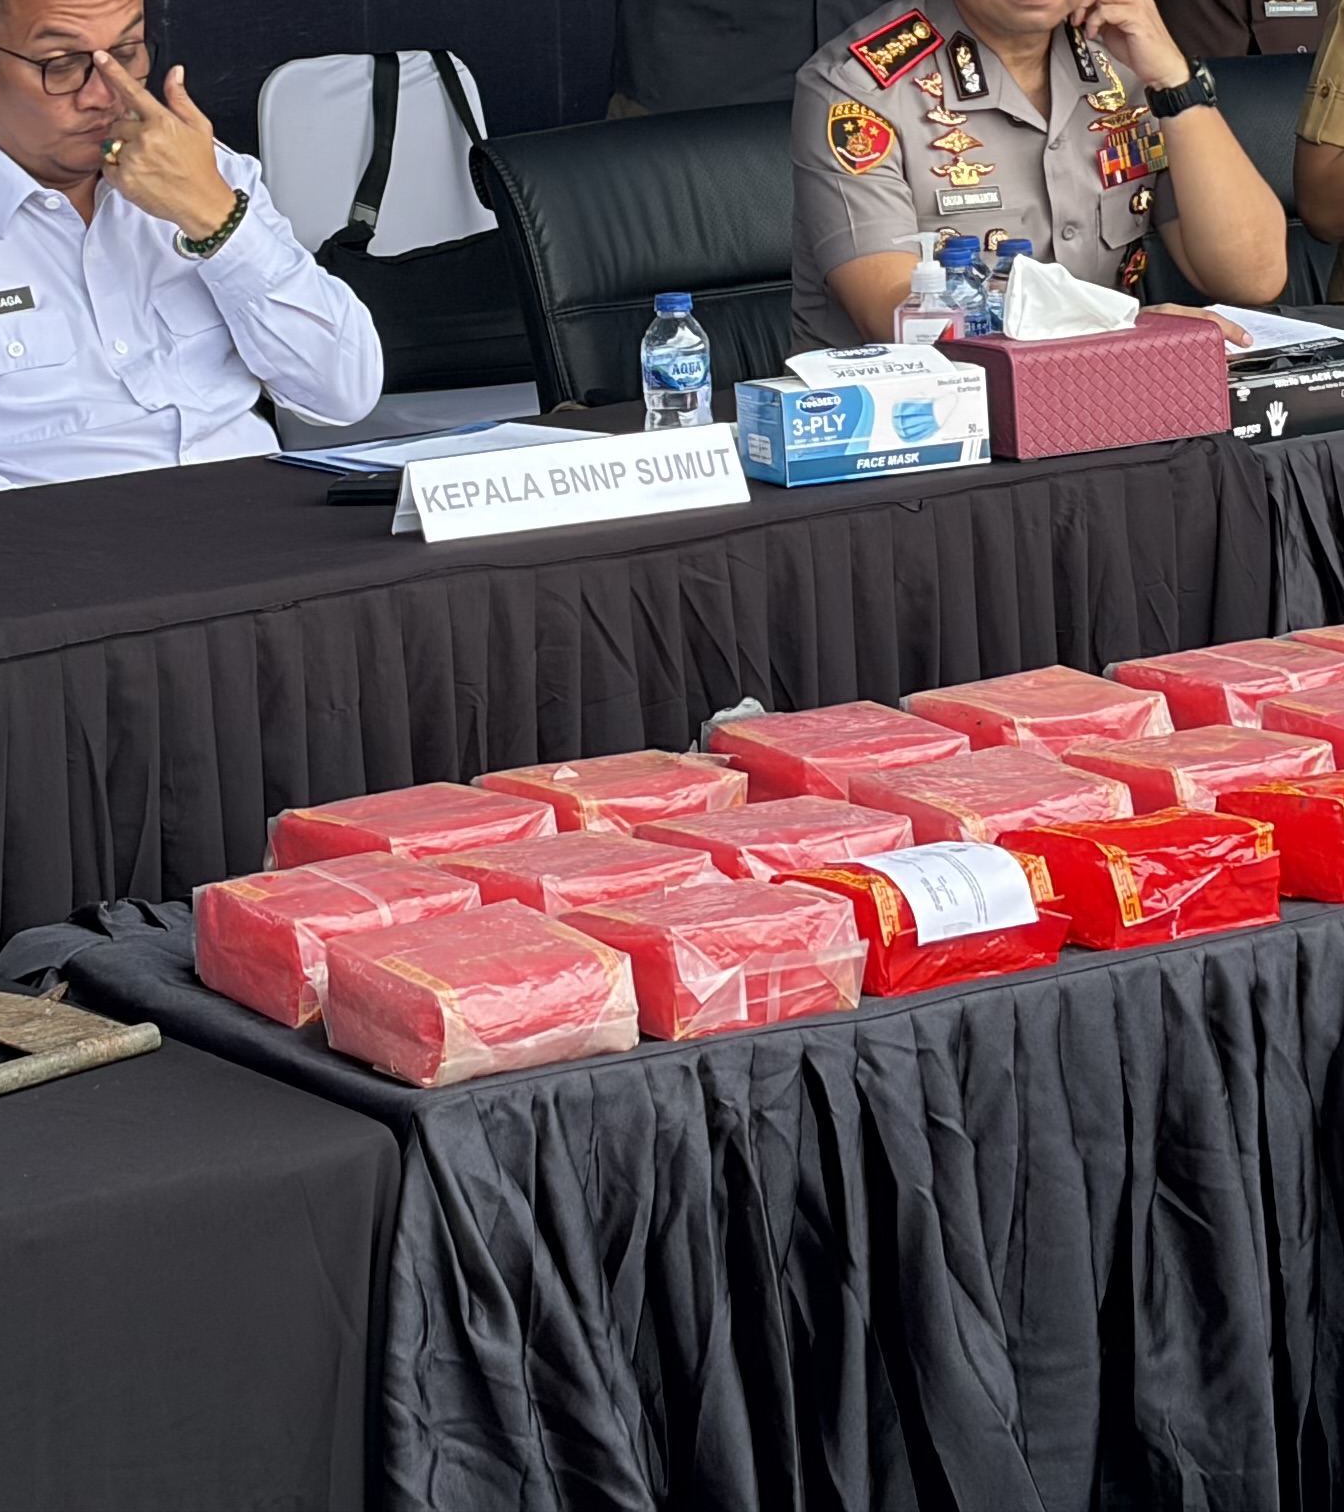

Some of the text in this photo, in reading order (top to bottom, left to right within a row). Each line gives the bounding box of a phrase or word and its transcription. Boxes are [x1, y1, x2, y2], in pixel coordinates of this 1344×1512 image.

[671, 361, 702, 376] AQUA
[792, 413, 846, 437] 3-PLY
[968, 423, 977, 434] 50
[856, 452, 920, 470] FACE MASK
[421, 472, 545, 513] KEPALA
[548, 461, 627, 496] BNNP
[634, 448, 730, 486] SUMUT
